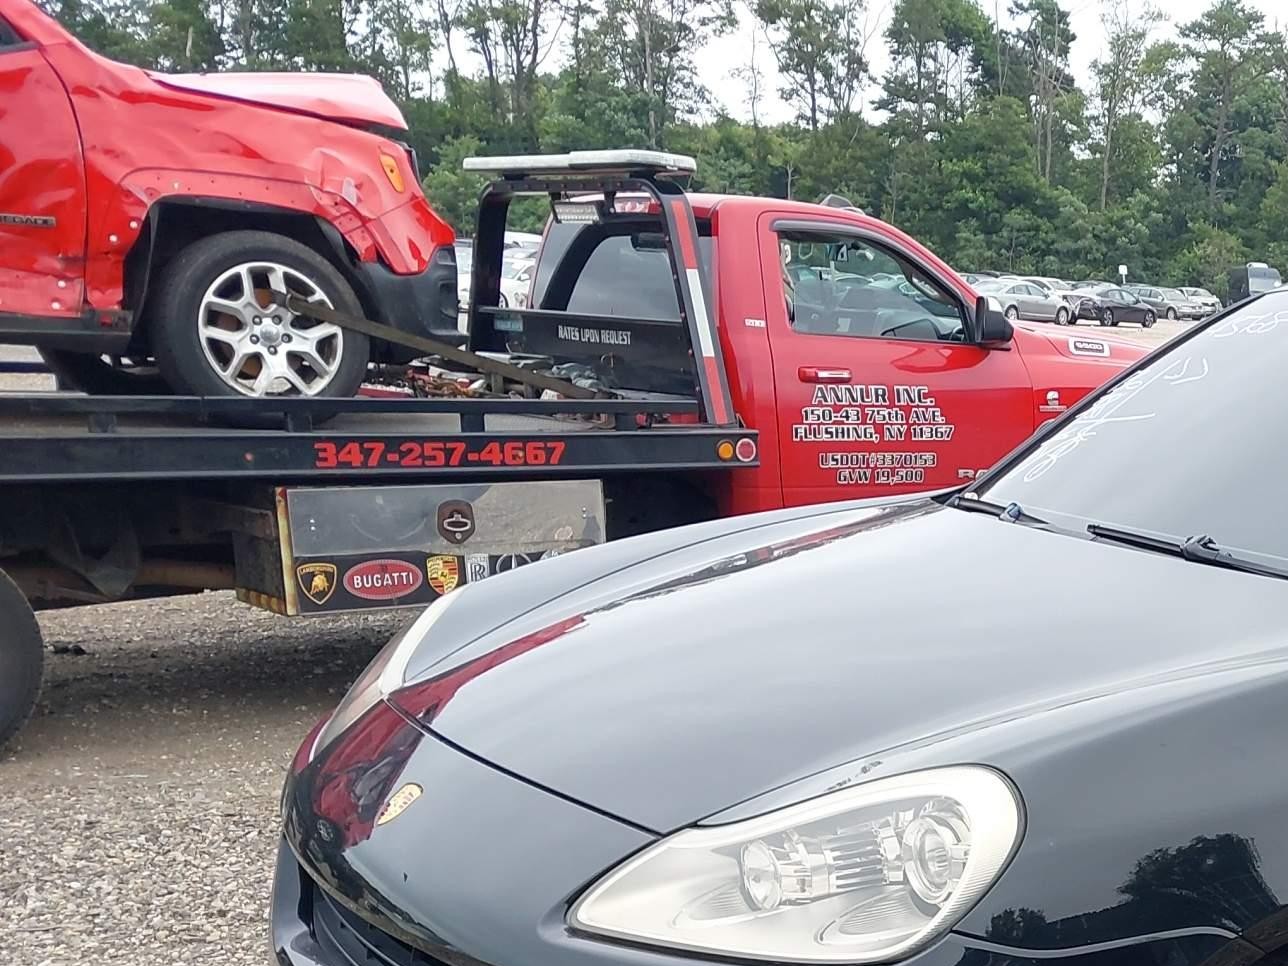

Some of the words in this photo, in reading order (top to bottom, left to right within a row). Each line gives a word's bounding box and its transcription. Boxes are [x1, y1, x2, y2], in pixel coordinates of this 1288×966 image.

[558, 325, 580, 341] RATES
[580, 328, 600, 343] UPON
[601, 330, 631, 345] REQUEST
[812, 385, 890, 406] ANNUR
[894, 386, 936, 405] INC.
[801, 407, 861, 424] 150-43
[865, 408, 906, 424] 75th
[908, 408, 946, 424] AVE.
[793, 424, 881, 444] FLUSHING,
[883, 425, 908, 441] NY
[910, 425, 955, 441] 11367
[313, 441, 567, 467] 347-257-4667
[836, 469, 871, 485] GVW
[874, 469, 924, 485] 19,500
[353, 571, 414, 590] BUGATTI
